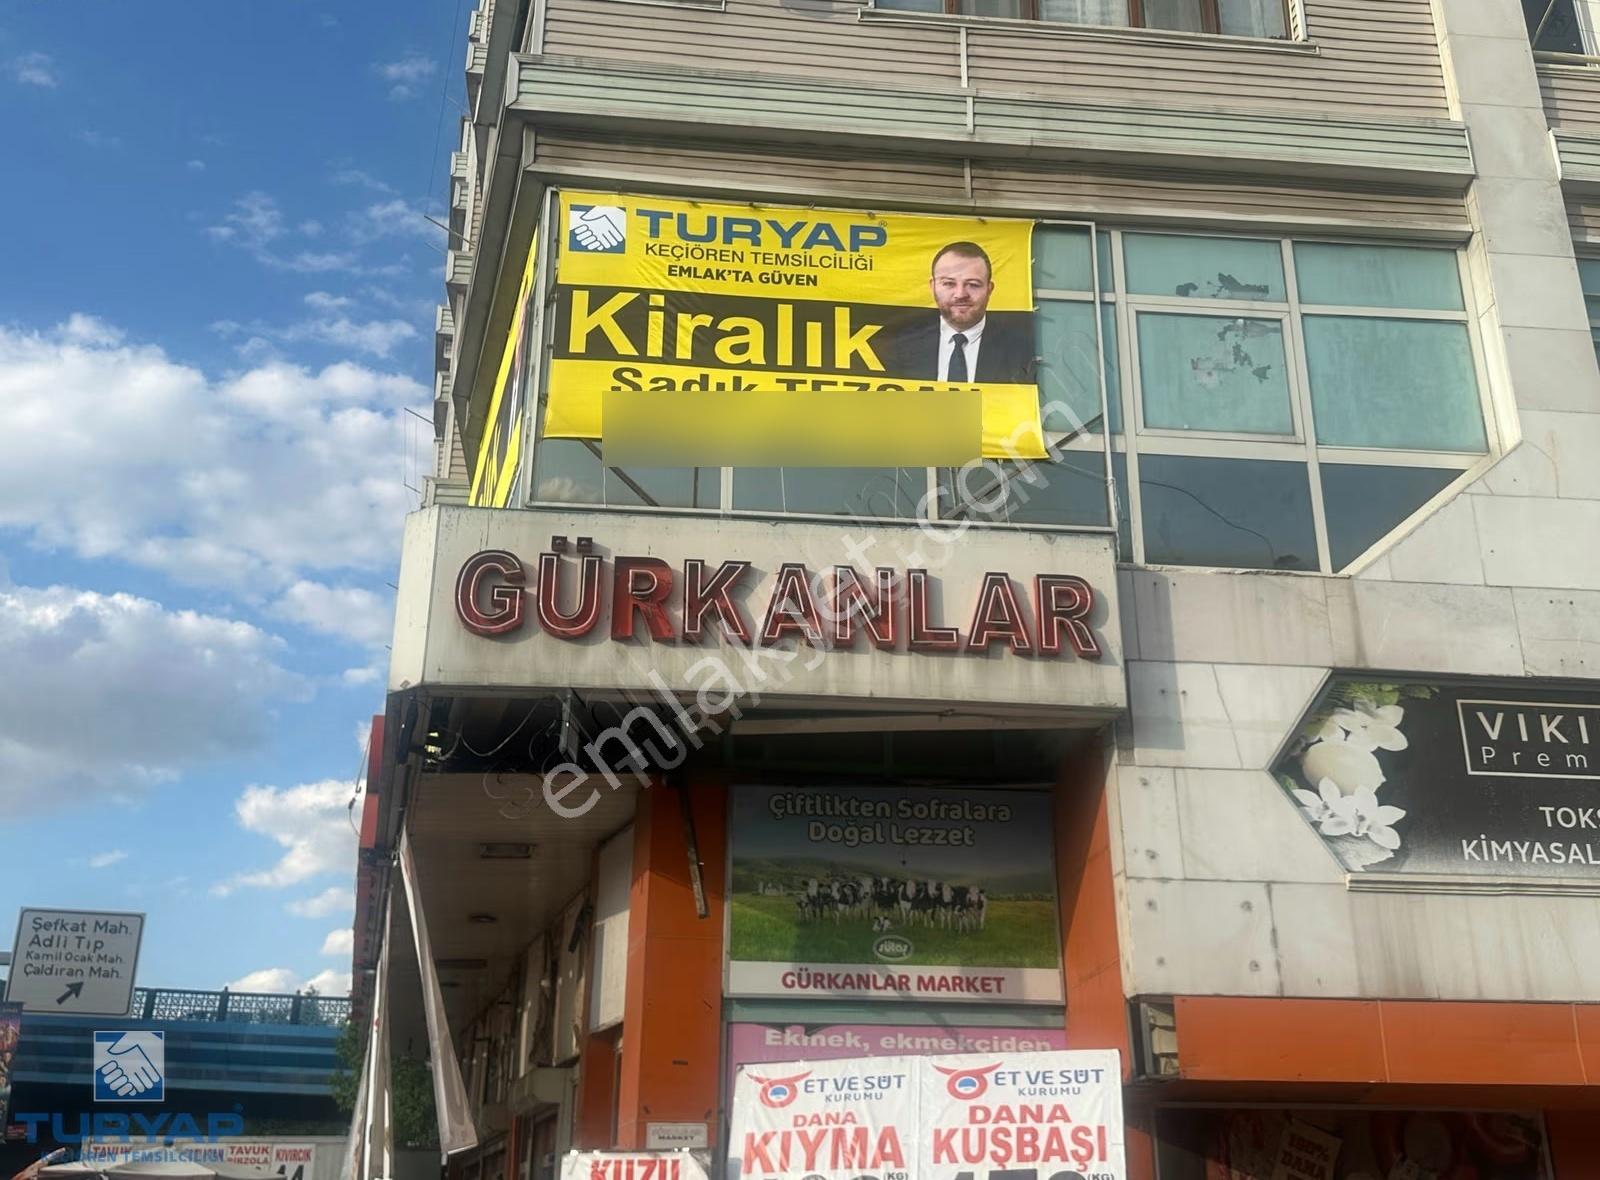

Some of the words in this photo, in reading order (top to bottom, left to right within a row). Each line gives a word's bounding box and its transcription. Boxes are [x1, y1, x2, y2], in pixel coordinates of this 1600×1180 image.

[636, 208, 888, 253] TURYAP
[645, 243, 744, 264] KEÇİÖREN
[750, 250, 873, 271] TEMSİLCİLİĞİ
[758, 271, 818, 286] GÜVEN
[568, 289, 886, 373] Kiralık
[455, 535, 1102, 658] GÜRKANLAR
[769, 794, 892, 820] Çiftlikten
[899, 799, 1012, 822] Sofralara
[808, 821, 885, 847] Doğal
[892, 825, 975, 846] Lezzet
[32, 917, 87, 932] Şefkat
[28, 934, 67, 949] Adli
[26, 951, 62, 961] Kamil
[64, 952, 94, 962] Ocak
[24, 963, 84, 977] Çaldıran
[781, 968, 910, 992] GÜRKANLAR
[916, 975, 1005, 994] MARKET
[764, 1029, 870, 1051] Ekmek,
[804, 1079, 829, 1093] ET
[833, 1078, 858, 1092] VE
[863, 1075, 906, 1090] SÜT
[994, 1071, 1021, 1086] ET
[1025, 1071, 1053, 1085] VE
[1059, 1069, 1104, 1085] SÜT
[824, 1092, 883, 1103] KURUMU
[1018, 1087, 1081, 1096] KURUMU
[793, 1111, 857, 1127] DANA
[969, 1104, 1072, 1124] DANA
[230, 1145, 269, 1154] TAVUK
[743, 1126, 906, 1174] KIYMA
[933, 1125, 1107, 1172] KUŞBAŞI
